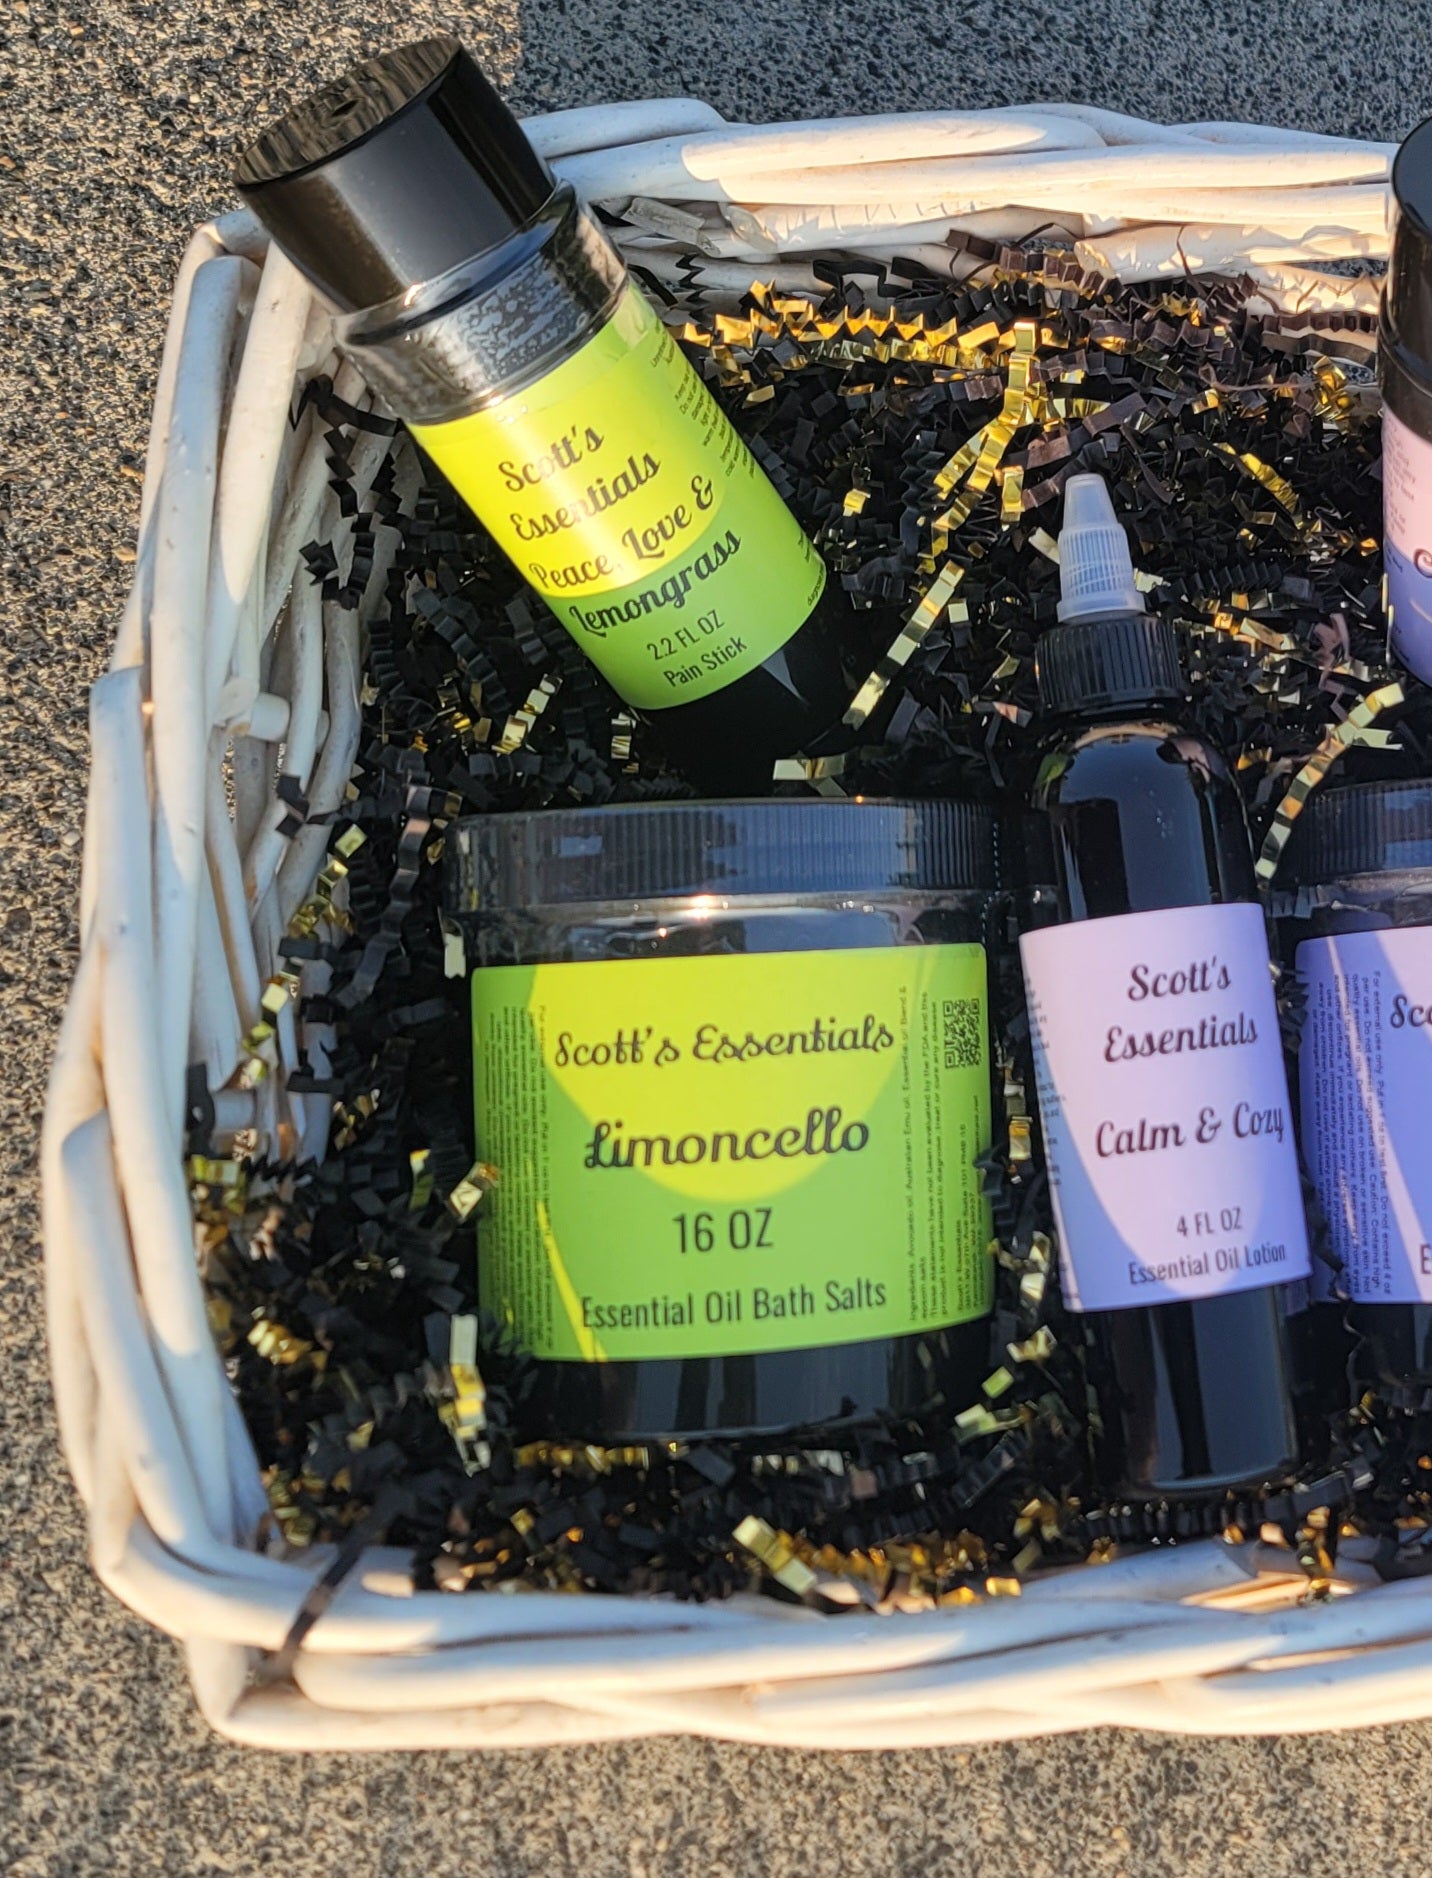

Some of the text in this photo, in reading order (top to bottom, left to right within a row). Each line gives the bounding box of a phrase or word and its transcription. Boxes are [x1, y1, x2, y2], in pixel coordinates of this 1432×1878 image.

[498, 425, 604, 491] Scott's
[510, 453, 661, 541] Essentials
[622, 505, 693, 560] Love
[691, 475, 714, 510] &
[569, 530, 741, 638] Lemongrass
[647, 609, 725, 660] 2.2 FL OZ
[664, 636, 748, 687] Pain Stick
[1128, 955, 1232, 1002] Scott's
[554, 1014, 895, 1069] Scott's Essentials
[1103, 1012, 1259, 1064] Essentials
[583, 1107, 870, 1170] Limoncello
[1096, 1101, 1285, 1159] Calm & Cozy
[673, 1207, 774, 1255] 16 OZ
[1177, 1207, 1243, 1237] 4 FL OZ
[1129, 1241, 1286, 1286] Essential Oil Lotion
[581, 1277, 887, 1330] Essential Oil Bath Salts
